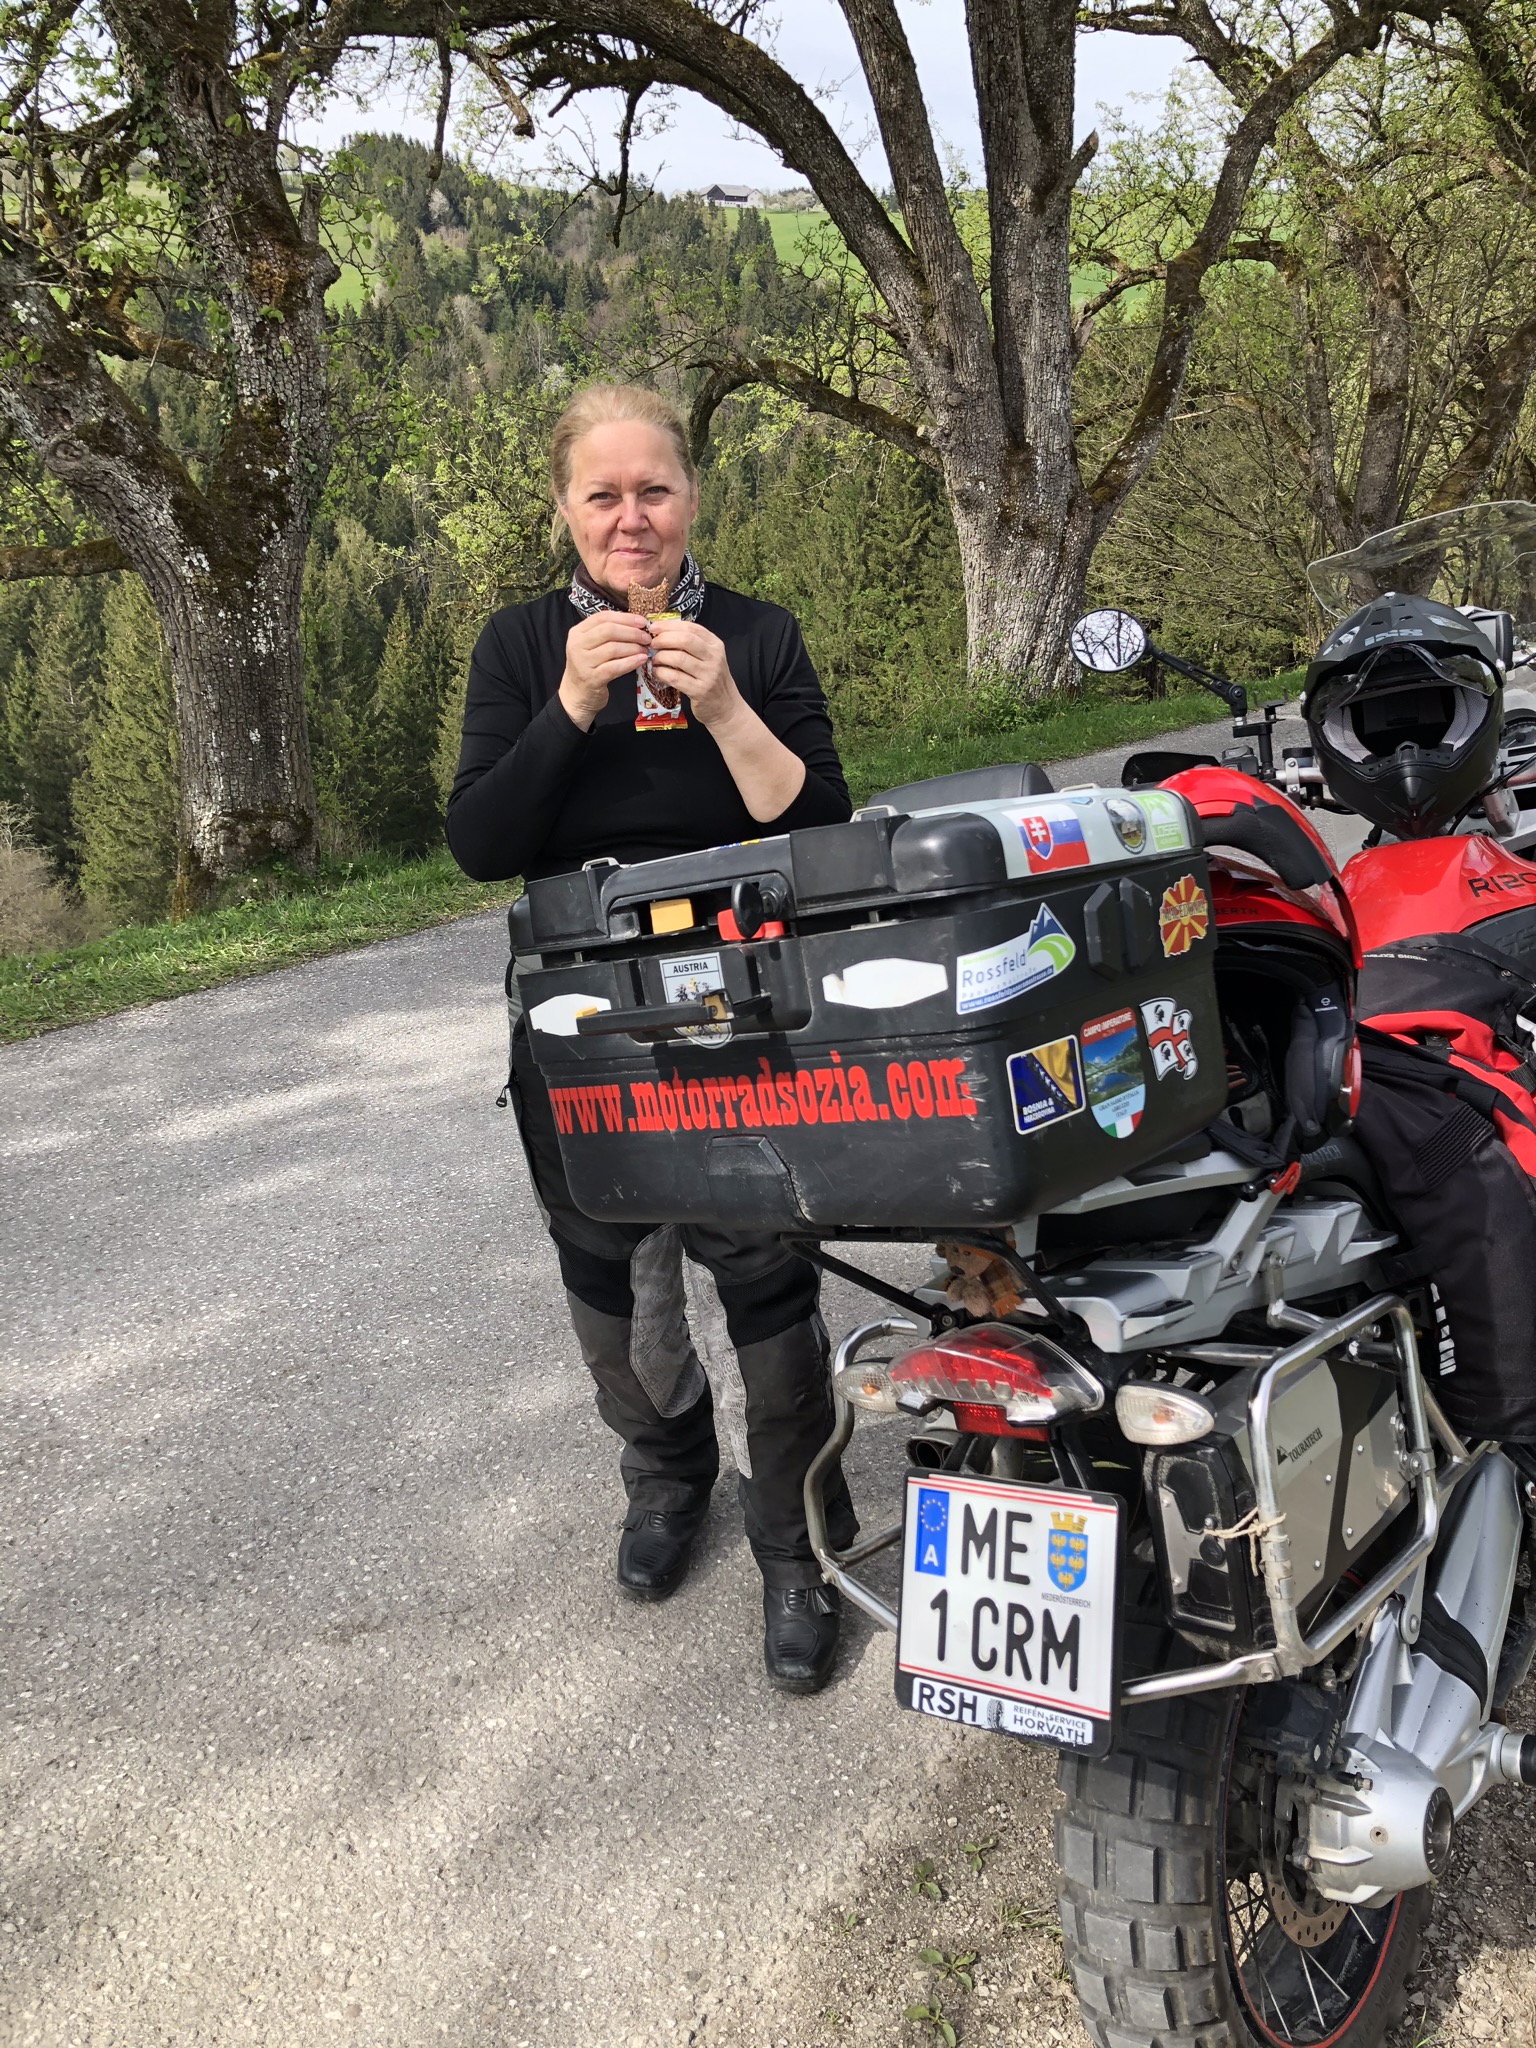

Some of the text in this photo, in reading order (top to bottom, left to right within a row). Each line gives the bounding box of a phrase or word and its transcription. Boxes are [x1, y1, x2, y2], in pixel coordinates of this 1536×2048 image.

[673, 961, 708, 974] AUSTRIA
[962, 949, 1026, 988] Rossfeld
[549, 1050, 978, 1135] www.motorradsozia.com
[1022, 1099, 1048, 1116] BOSNIA
[1287, 1428, 1323, 1463] TOURATECH
[922, 1544, 939, 1568] A
[961, 1503, 1033, 1586] ME
[930, 1588, 1081, 1692] 1 CRM
[918, 1681, 978, 1722] RSH
[1013, 1715, 1086, 1744] HORVATH
